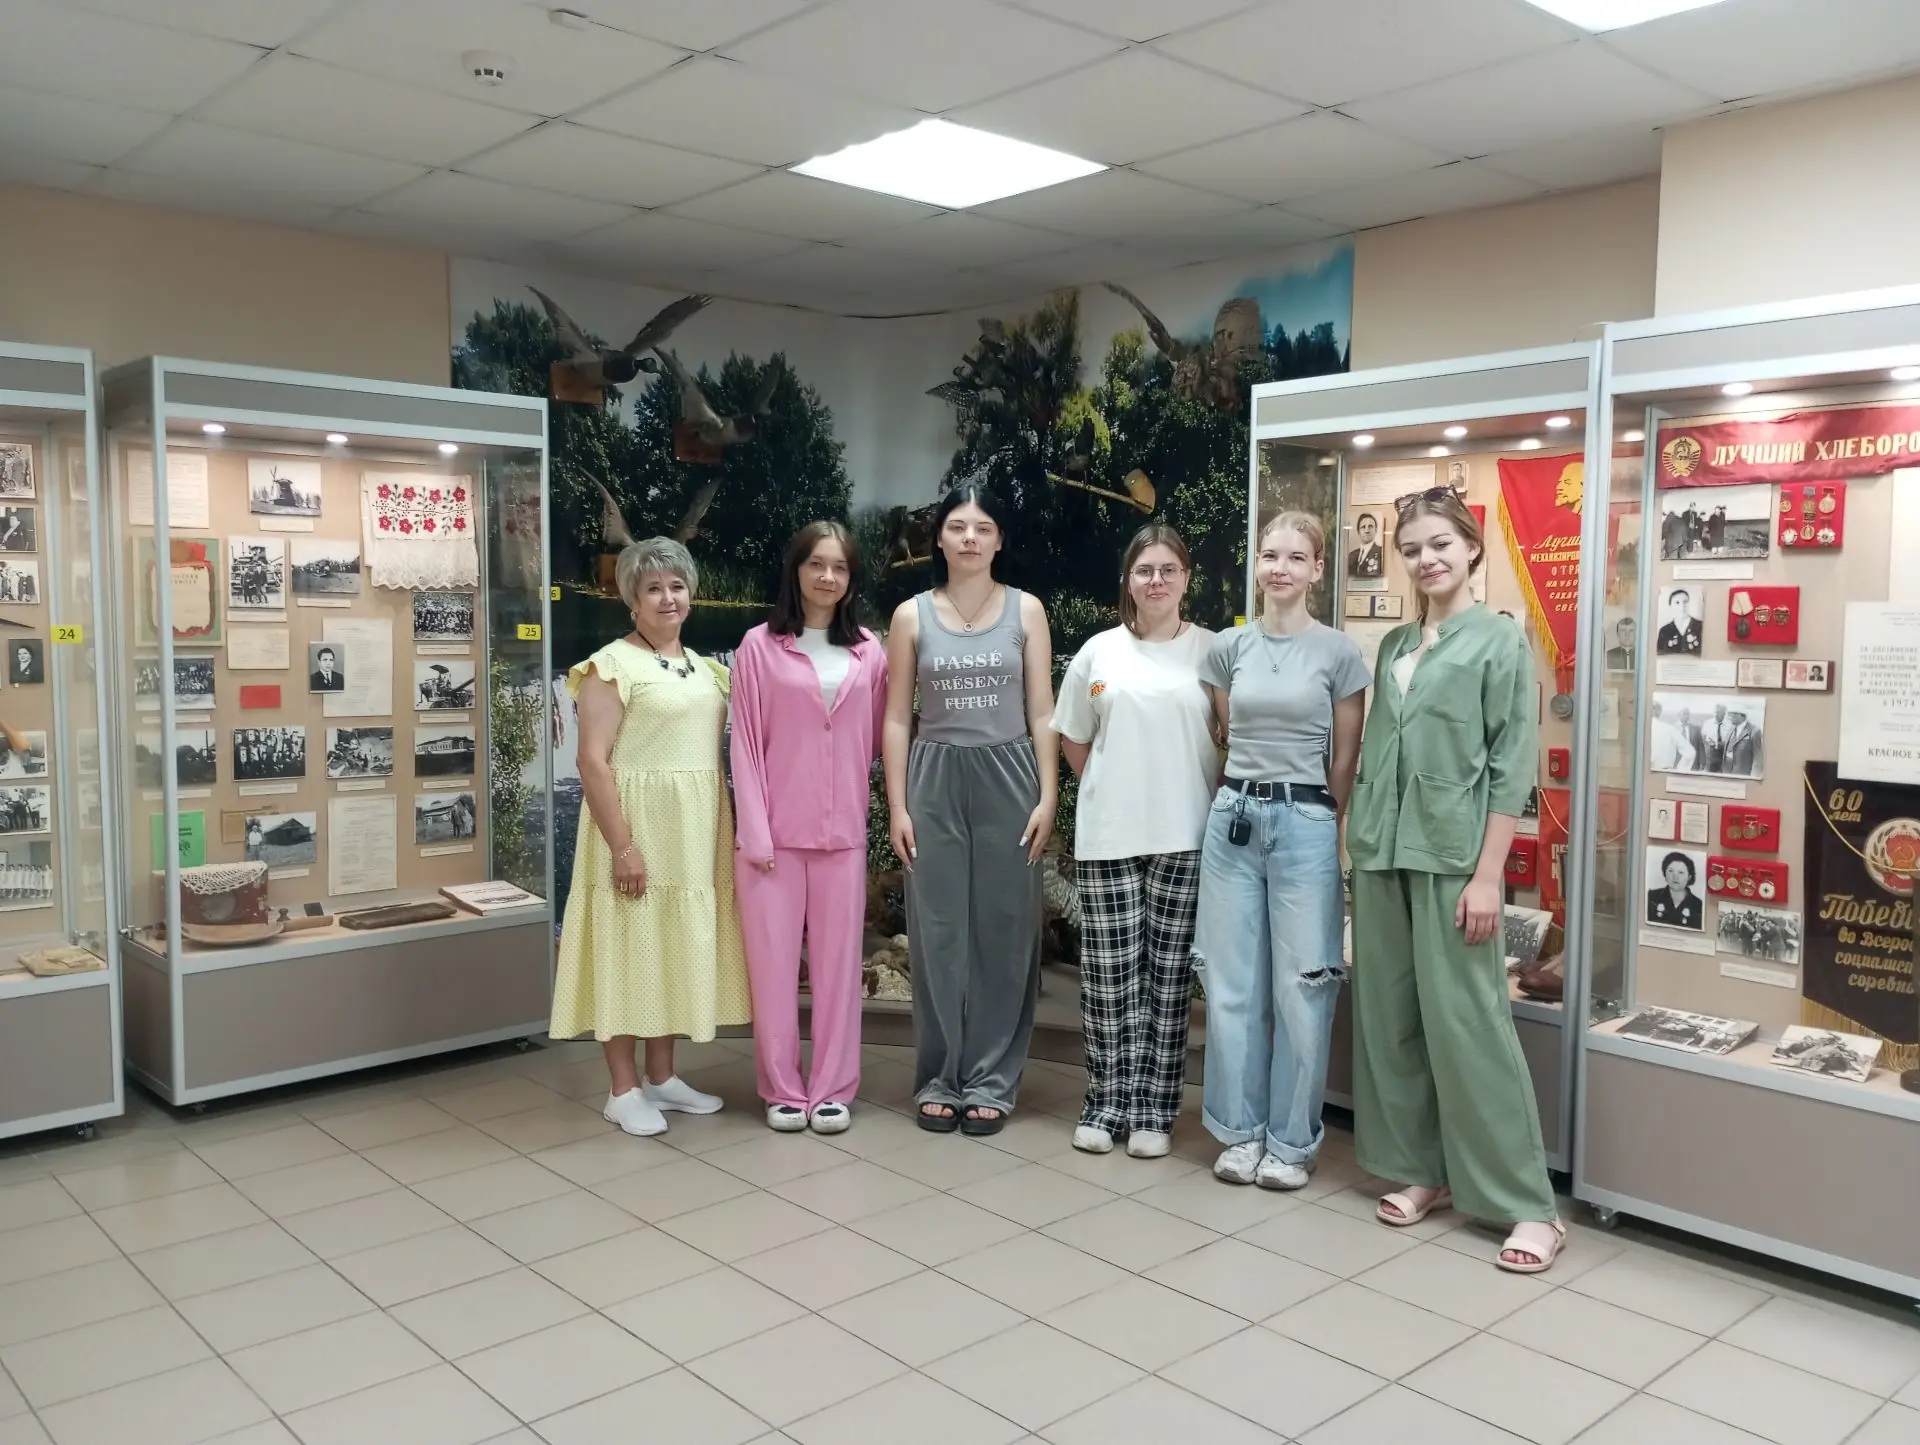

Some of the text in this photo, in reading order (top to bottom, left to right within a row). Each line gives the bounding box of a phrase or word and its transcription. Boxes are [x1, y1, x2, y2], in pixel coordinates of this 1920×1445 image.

[1815, 431, 1920, 461] ХЛЕБОРО
[59, 628, 75, 640] 24
[525, 627, 537, 637] 25
[933, 649, 1002, 672] PASSÉ
[930, 675, 1012, 691] PRÉSENT
[944, 694, 999, 710] FUTUR
[1868, 747, 1912, 759] КРАСНОЕ
[1829, 788, 1864, 811] 60
[1828, 811, 1862, 823] лет
